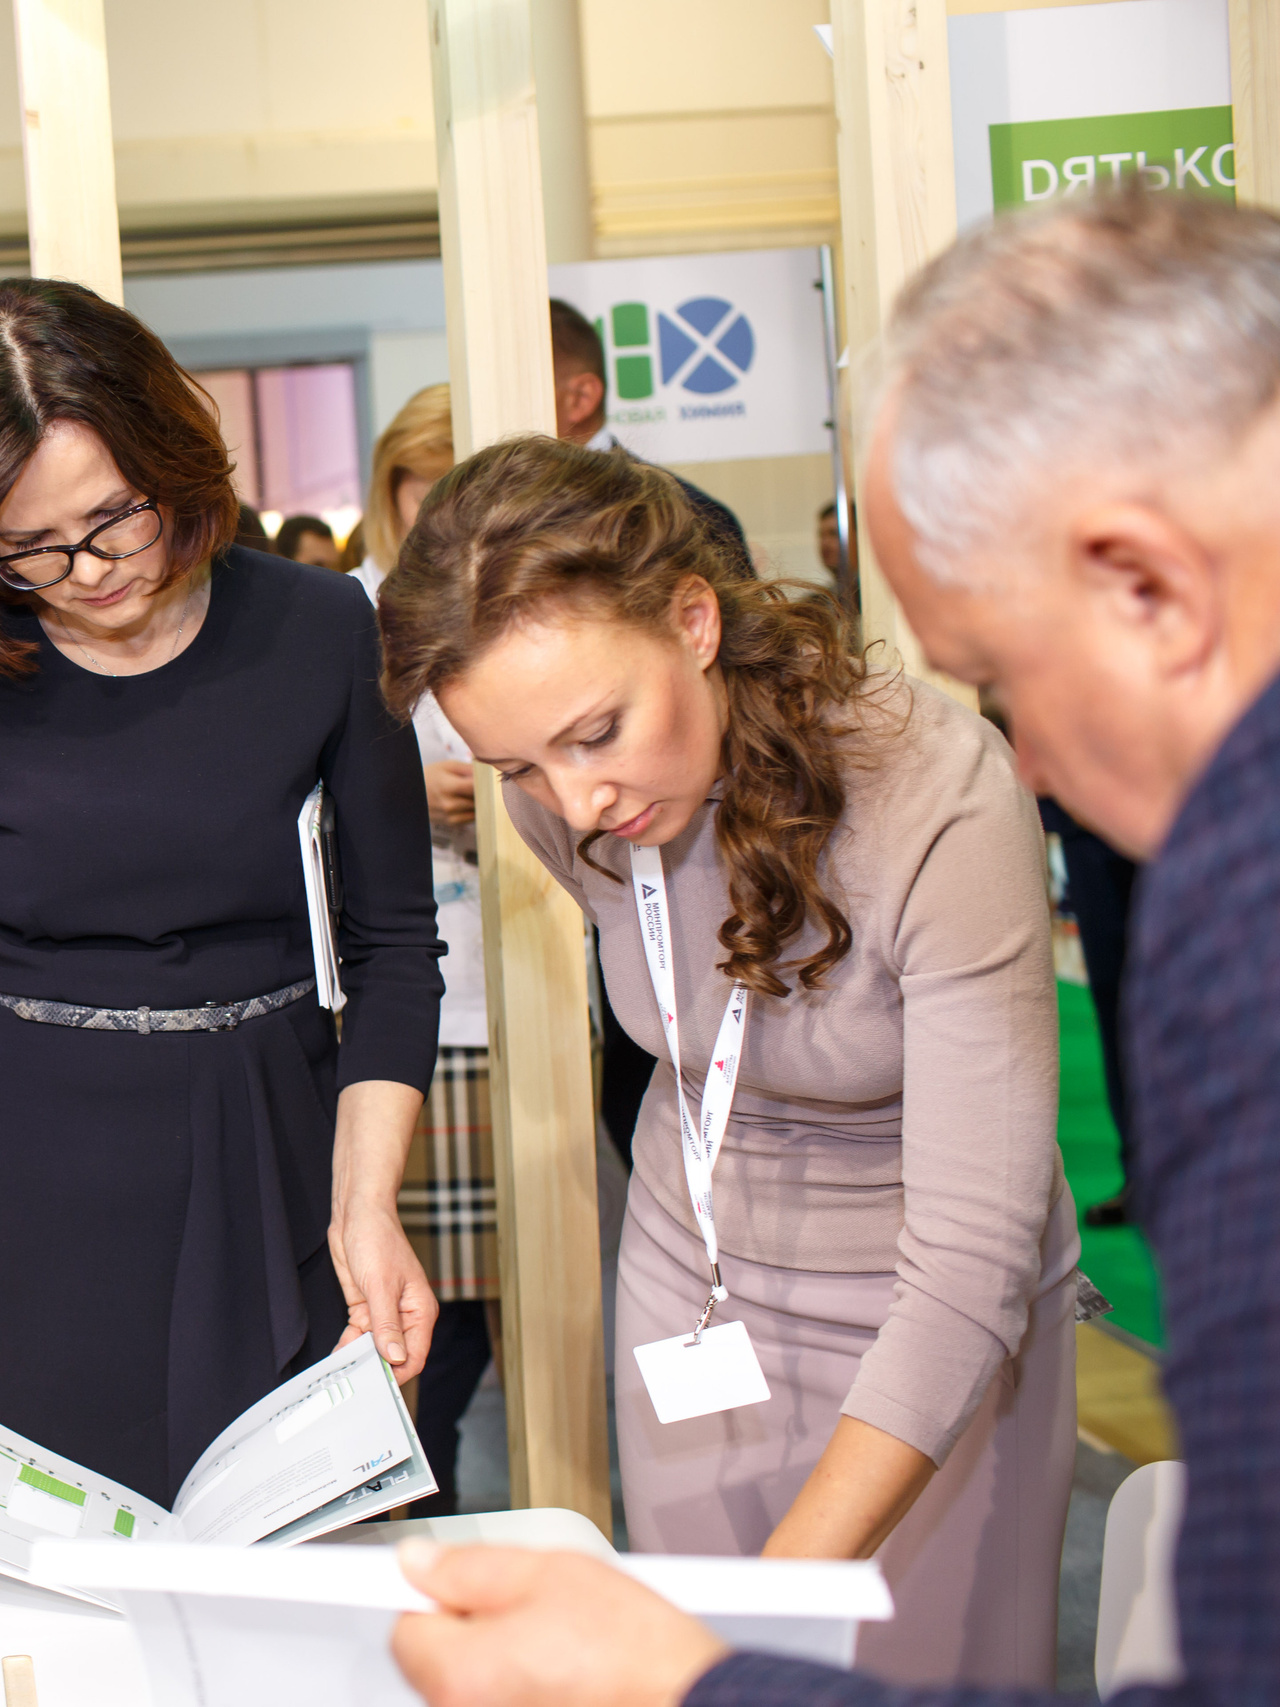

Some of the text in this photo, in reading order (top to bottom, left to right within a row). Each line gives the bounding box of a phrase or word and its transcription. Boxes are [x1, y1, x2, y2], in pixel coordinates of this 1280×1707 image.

[644, 903, 656, 941] РОССИИ
[652, 902, 667, 970] МИНПРОМТОРГ
[342, 1470, 410, 1505] PLATZ
